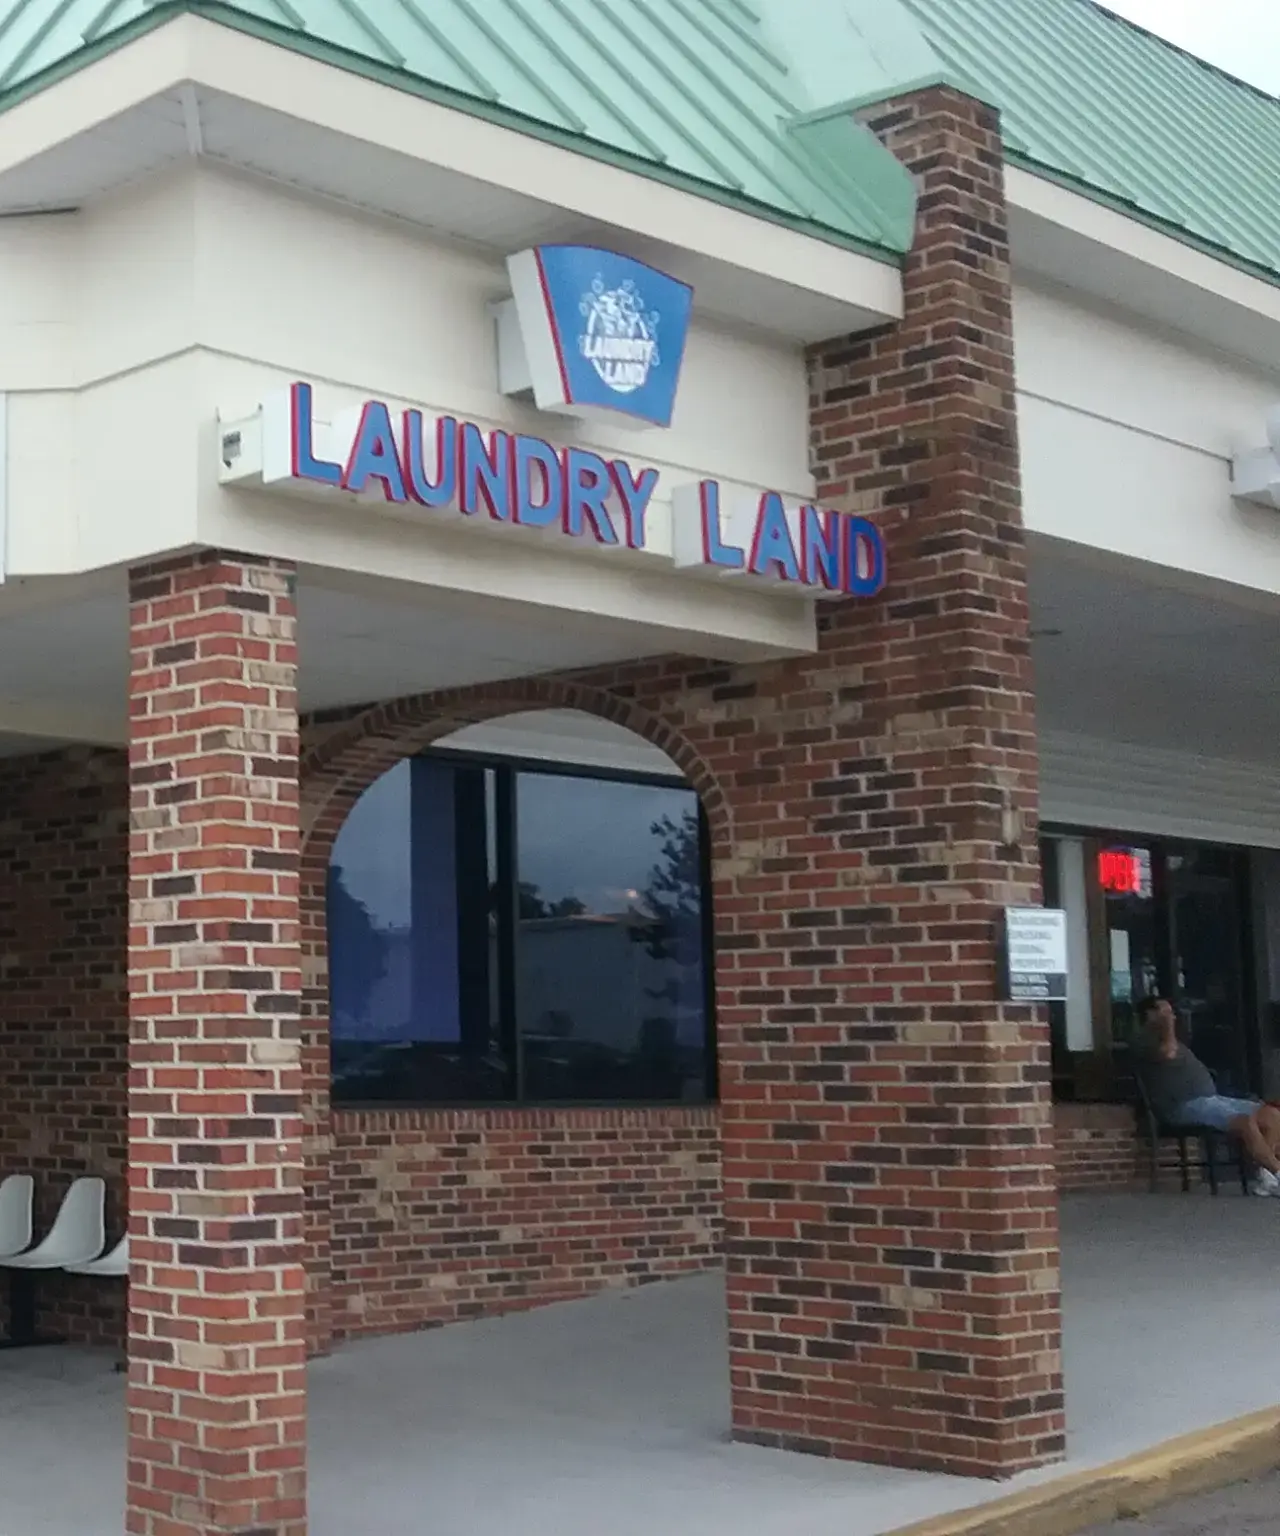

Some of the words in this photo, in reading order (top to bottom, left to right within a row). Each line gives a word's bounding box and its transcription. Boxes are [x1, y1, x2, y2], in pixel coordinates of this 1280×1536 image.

[584, 334, 655, 363] LAUNDRY
[604, 359, 649, 385] LAND
[291, 381, 660, 549] LAUNDRY
[699, 480, 887, 597] LAND
